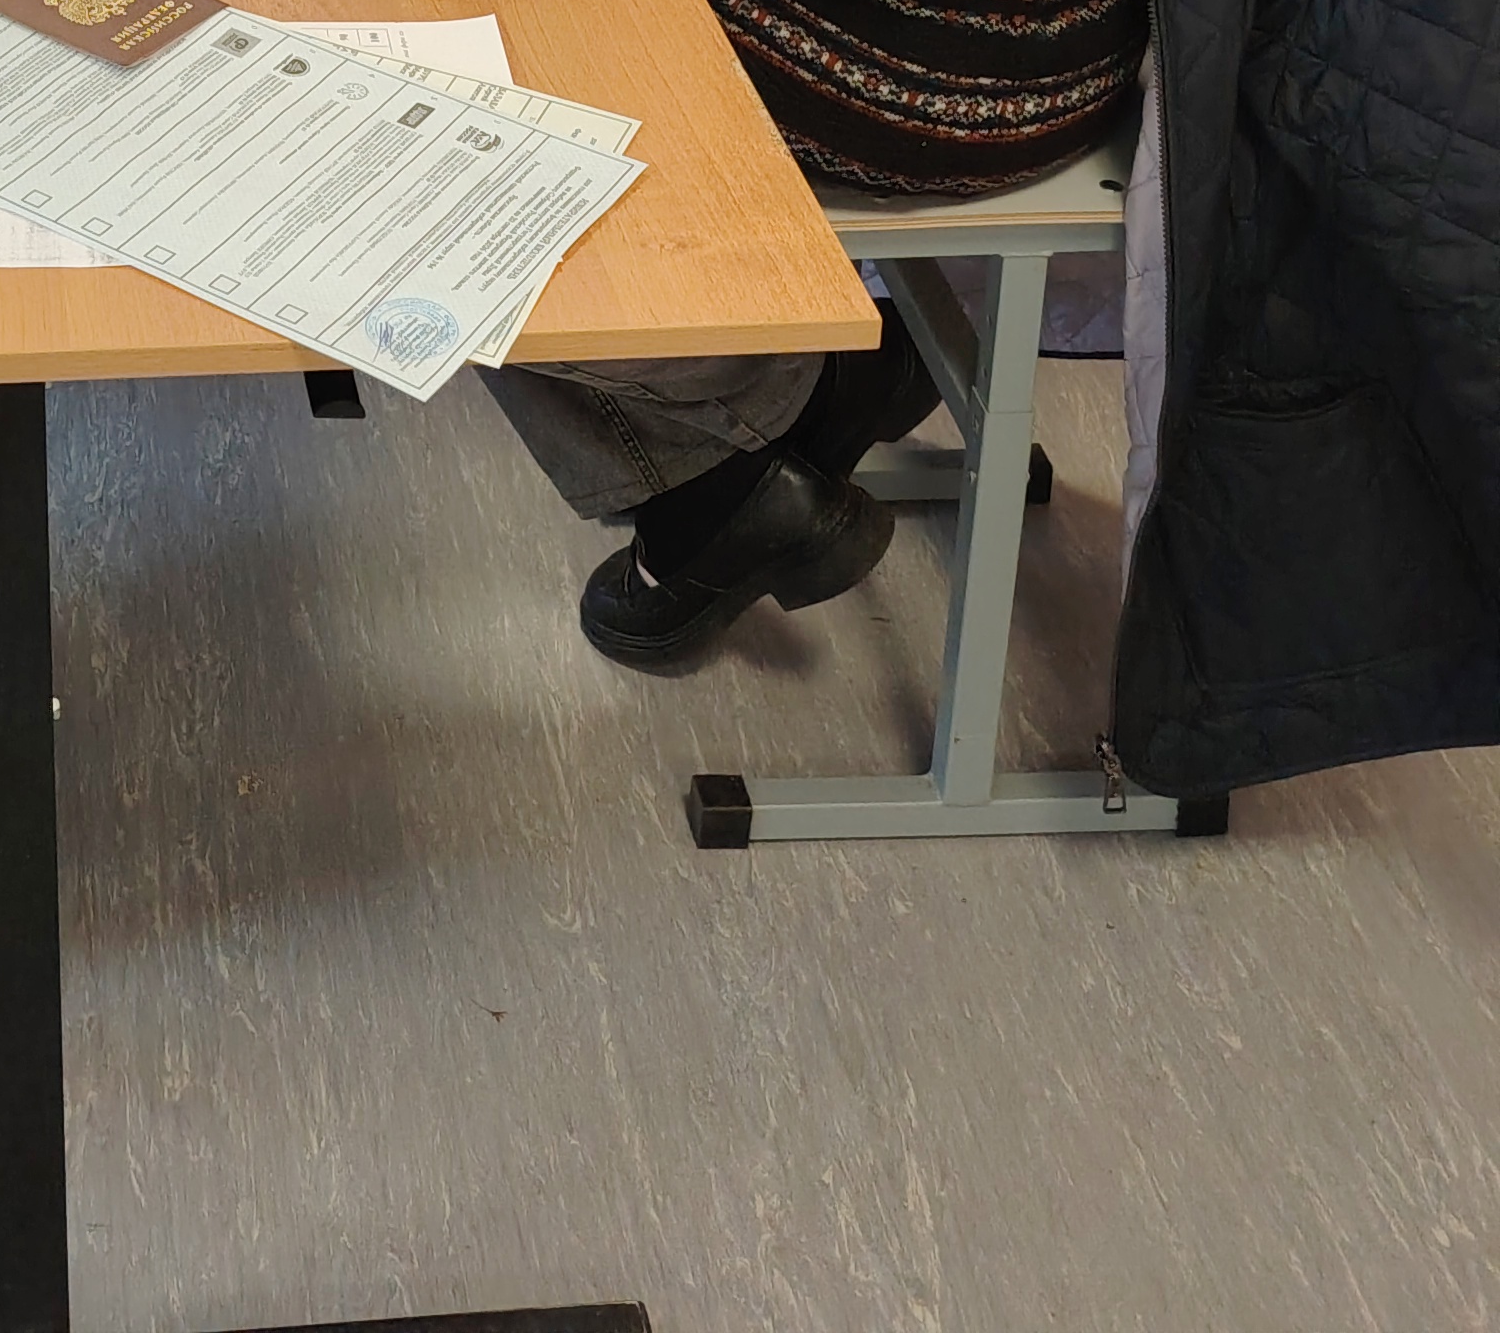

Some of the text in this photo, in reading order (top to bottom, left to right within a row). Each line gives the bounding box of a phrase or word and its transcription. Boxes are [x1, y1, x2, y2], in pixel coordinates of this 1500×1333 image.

[110, 0, 175, 45] ФЕДЕРАЦИЯ
[118, 1, 195, 51] РОССИЙСКАЯ
[538, 197, 590, 244] ИЗБИРАТЕЛЬНЫЙ
[504, 243, 546, 281] БЮЛЛЕТЕНЬ
